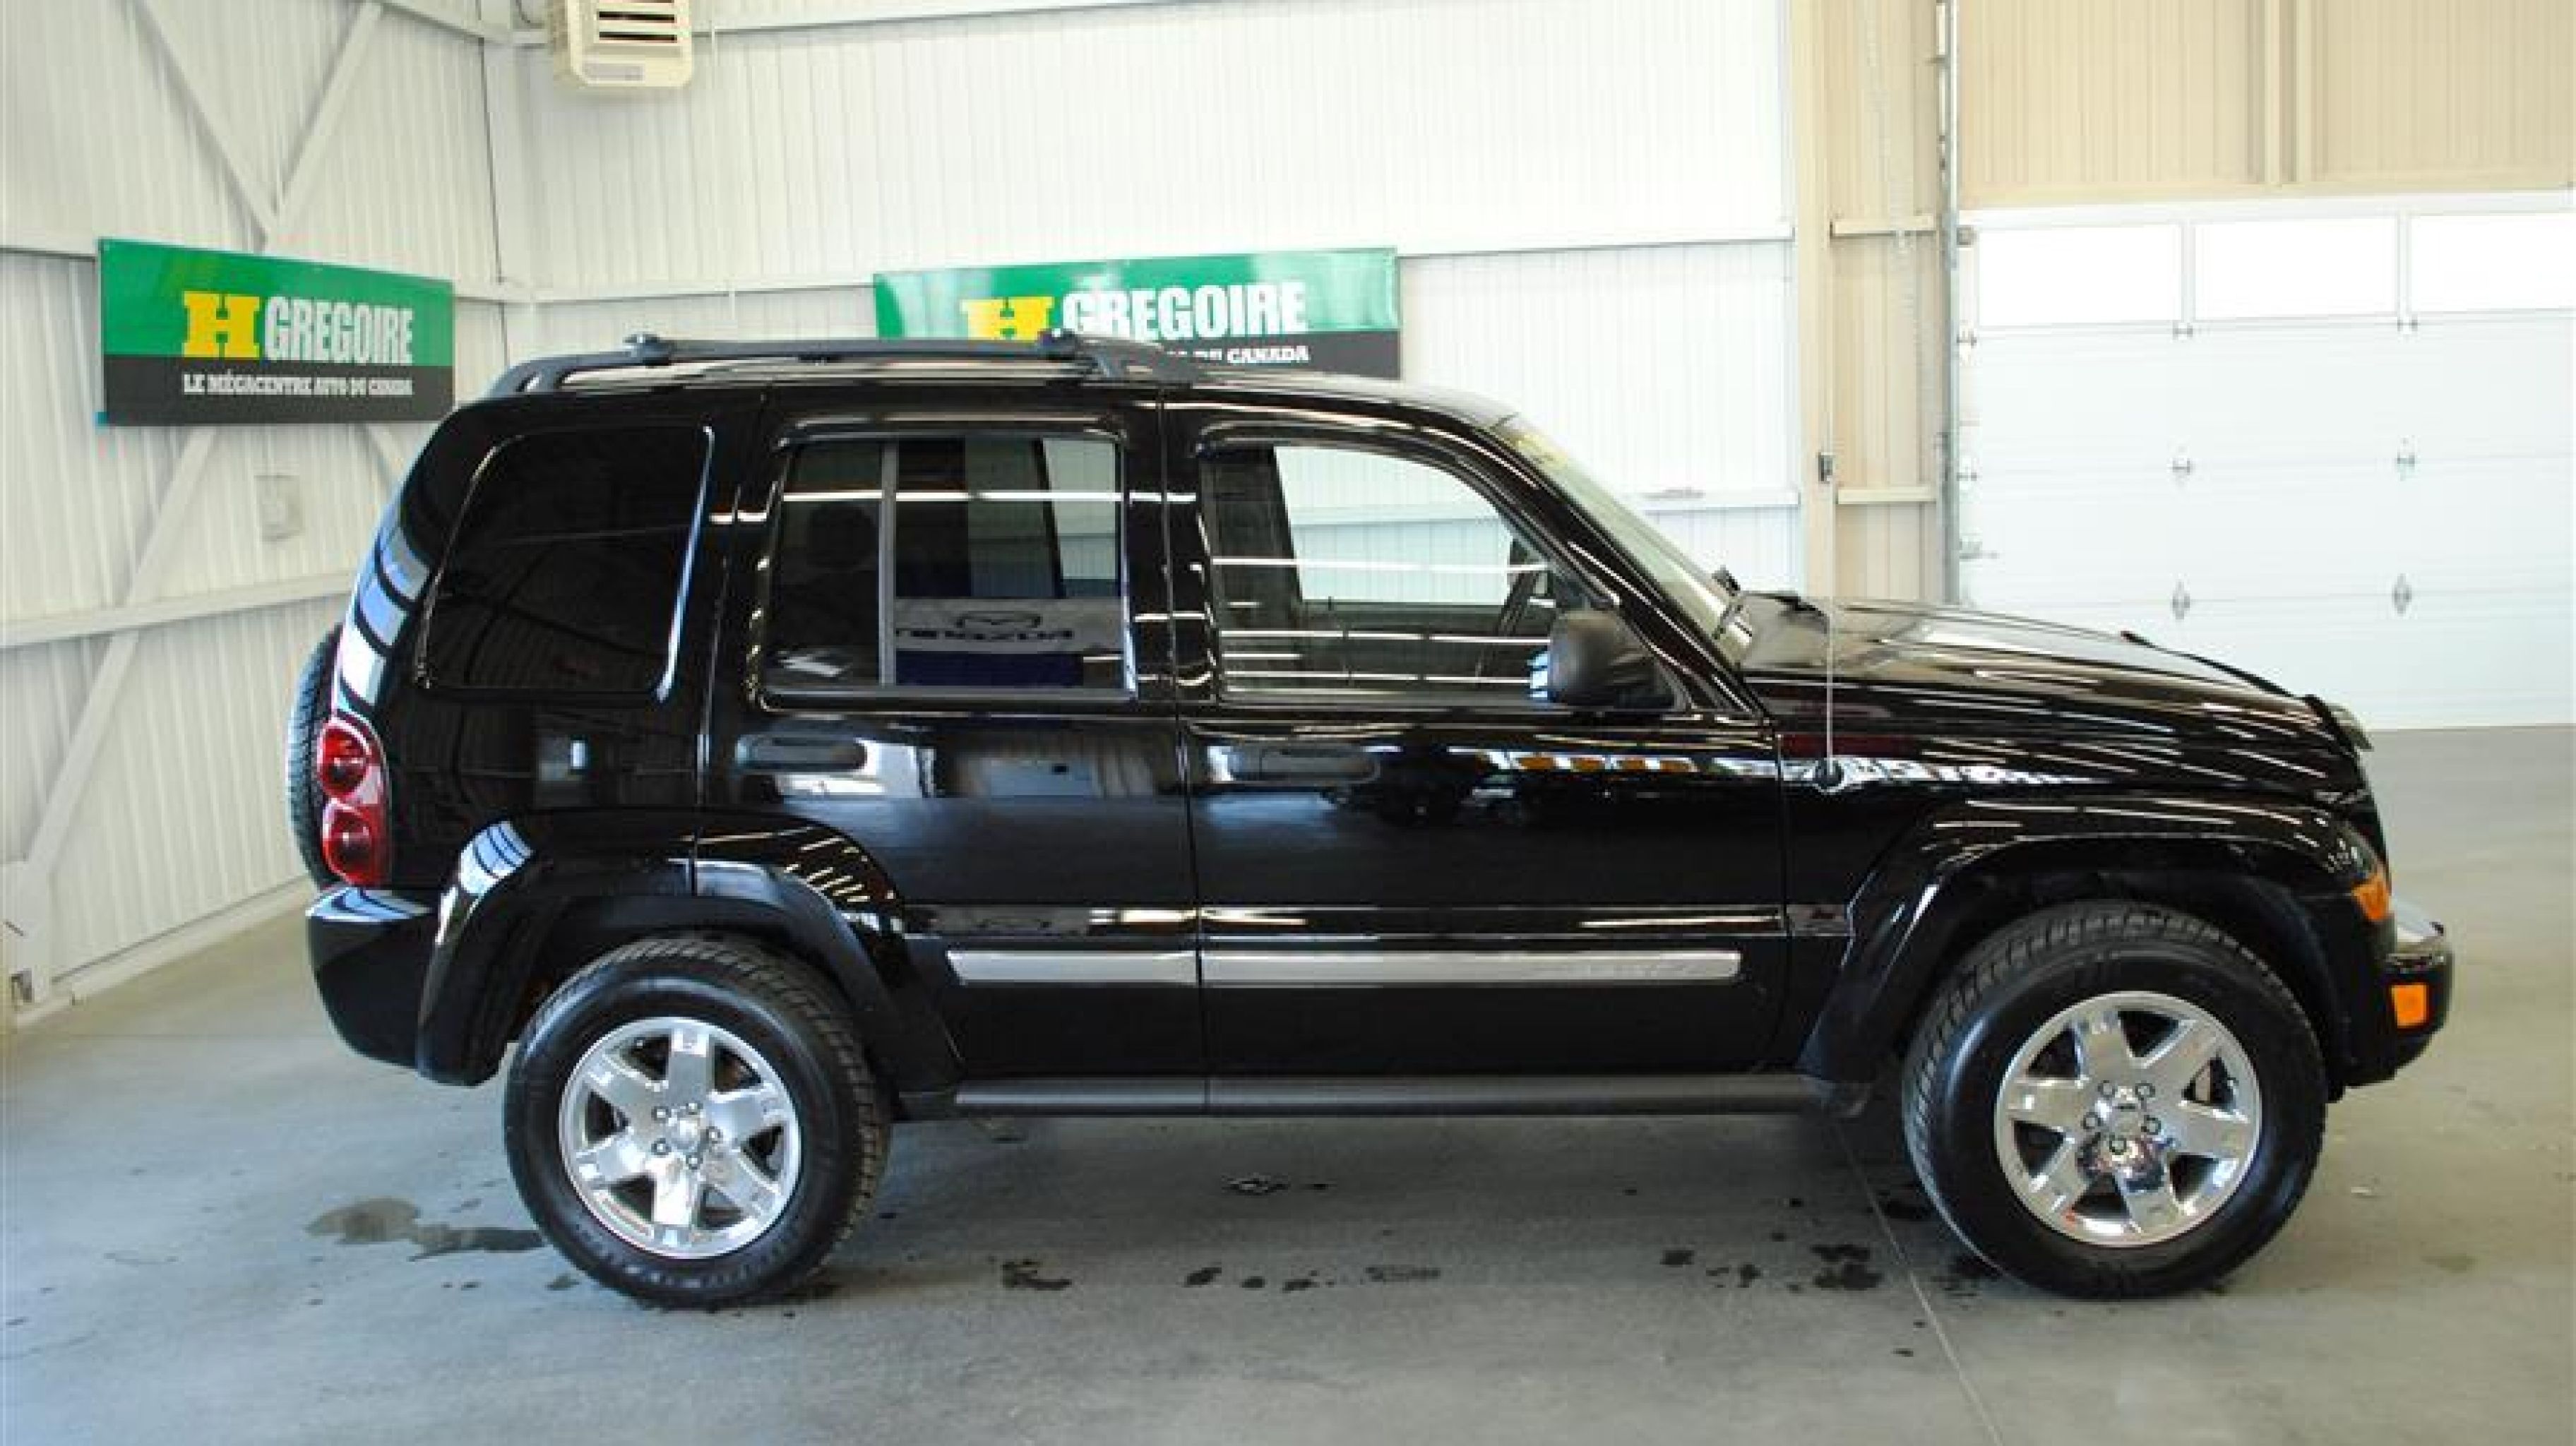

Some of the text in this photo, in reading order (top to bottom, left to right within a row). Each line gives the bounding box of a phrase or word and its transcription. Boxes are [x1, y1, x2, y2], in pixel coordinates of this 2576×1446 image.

[182, 290, 412, 365] H GREGOIRE
[960, 282, 1307, 342] H GREGOIRE
[1227, 346, 1311, 363] CANADA
[184, 374, 205, 395] LE
